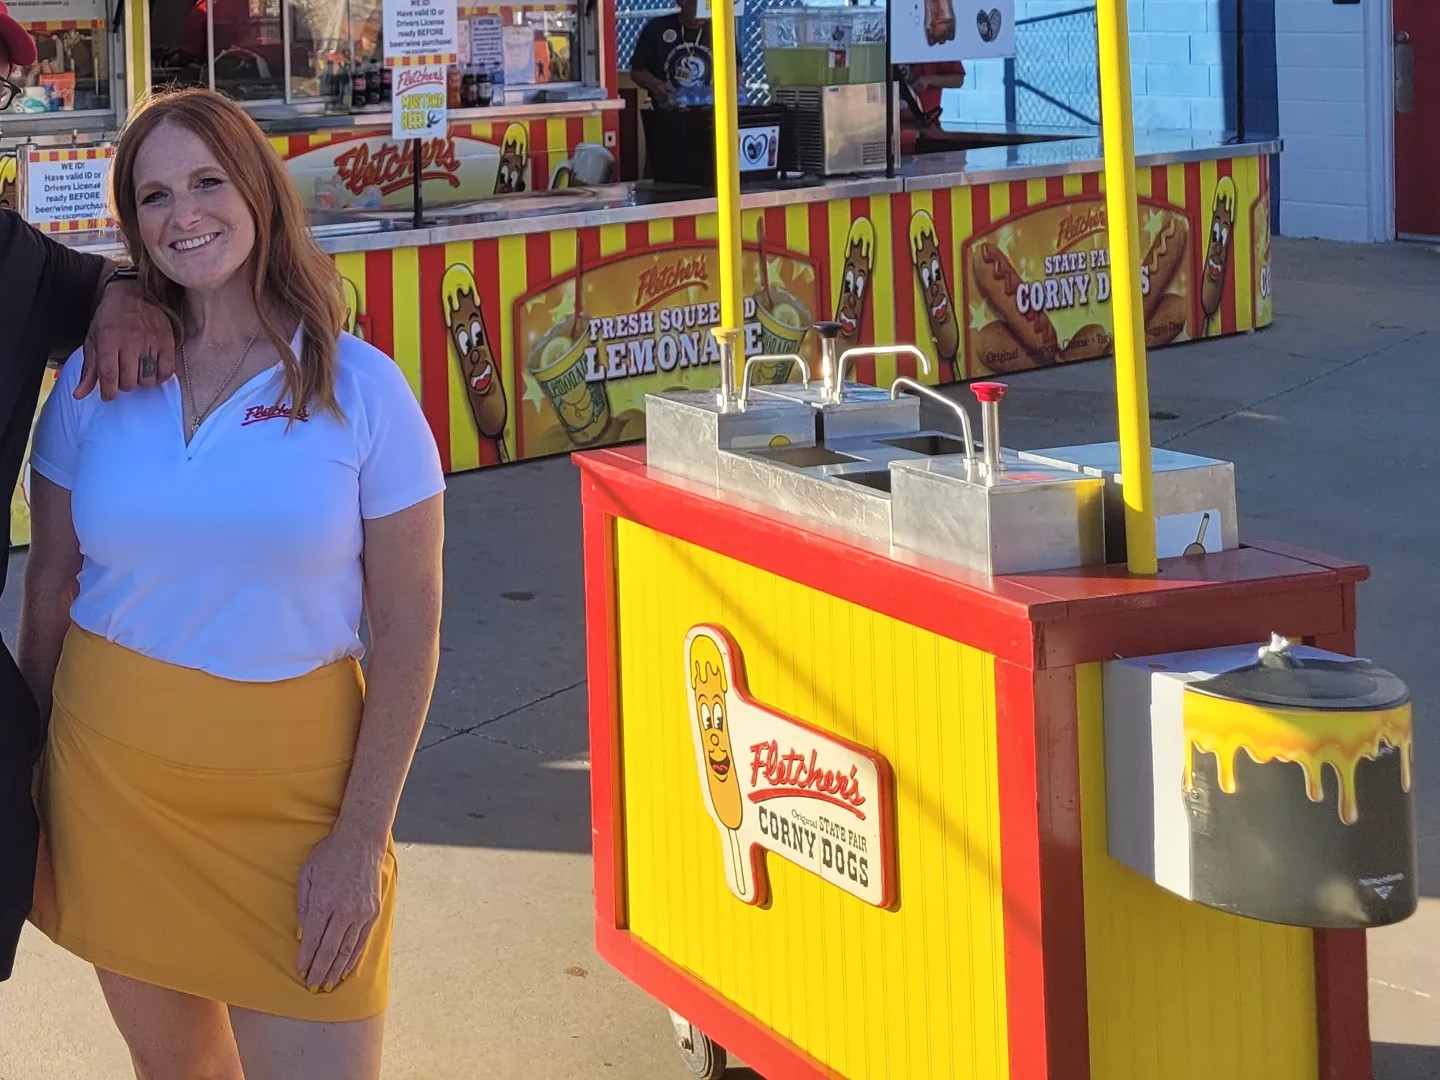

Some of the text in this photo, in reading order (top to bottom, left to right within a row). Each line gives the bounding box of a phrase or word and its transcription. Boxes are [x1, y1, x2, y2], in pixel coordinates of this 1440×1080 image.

[44, 184, 71, 192] Drivers
[46, 192, 100, 203] ready BEFORE
[66, 172, 83, 180] valid
[635, 254, 708, 305] Fletcher's
[1045, 252, 1087, 276] STATE
[1016, 273, 1091, 314] CORNY
[588, 296, 757, 342] FRESH SQUEED
[583, 322, 763, 383] LEMONAE
[986, 348, 1019, 363] Original
[748, 740, 866, 806] Fletcher's
[758, 805, 869, 888] CORNY DOGS
[791, 808, 868, 853] Original STATE FAIR
